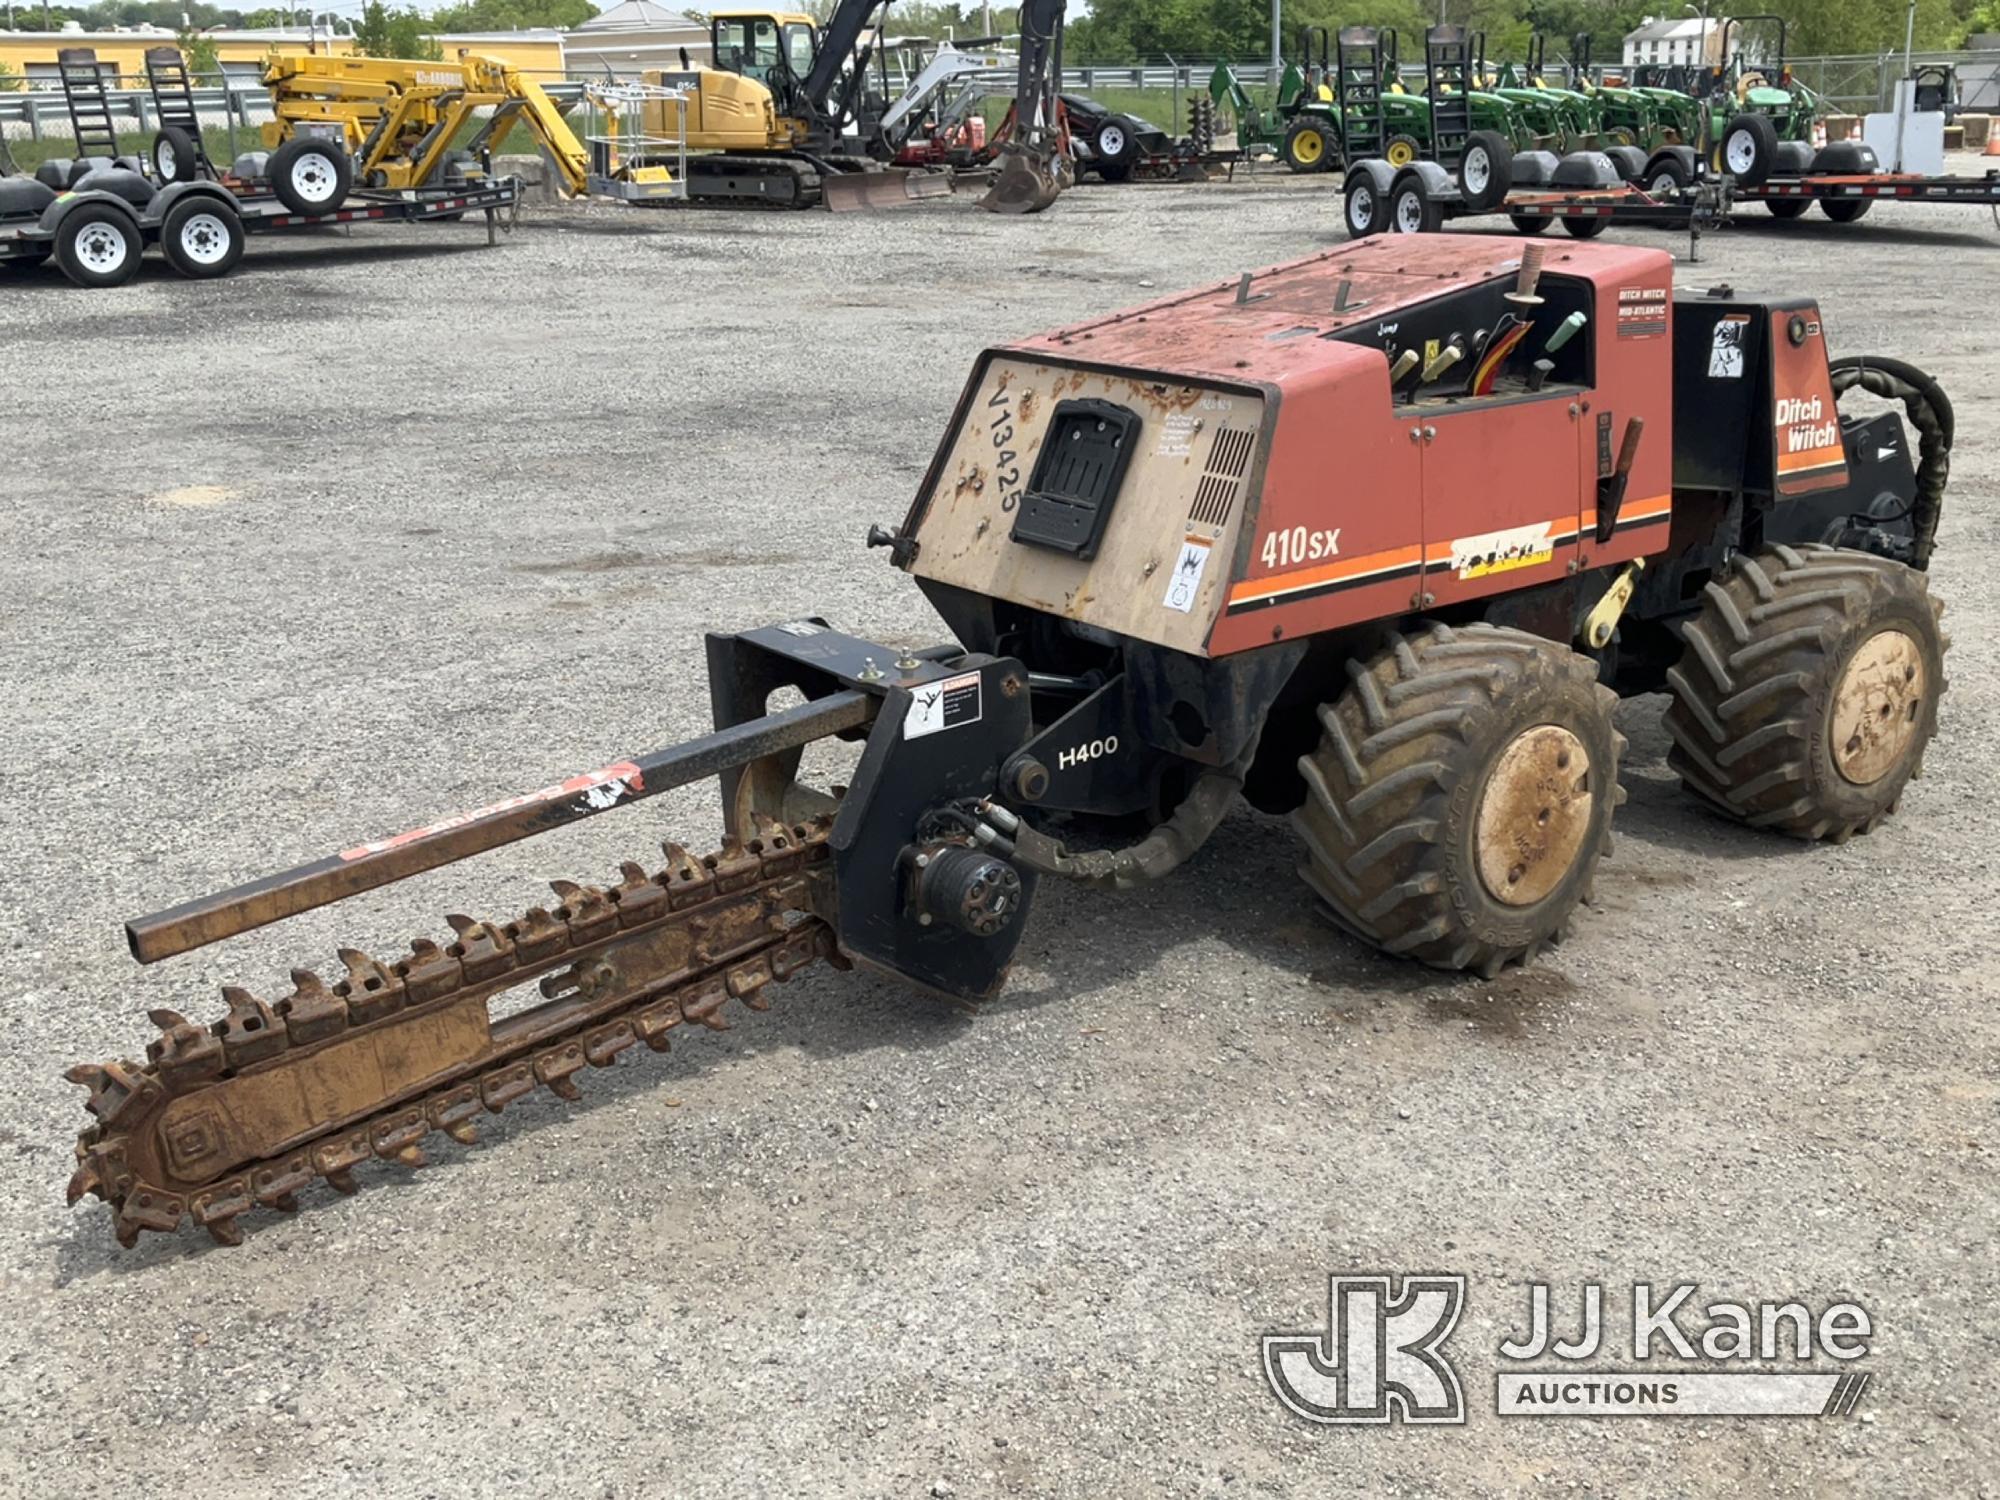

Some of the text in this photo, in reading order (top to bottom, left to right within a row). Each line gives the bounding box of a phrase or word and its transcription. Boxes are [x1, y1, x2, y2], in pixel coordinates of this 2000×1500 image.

[1619, 290, 1641, 301] DITCH
[1642, 288, 1666, 299] WITCH
[1775, 394, 1822, 426] Ditch
[988, 385, 1022, 514] V13425
[1788, 420, 1836, 452] Witch
[1058, 735, 1119, 771] H400
